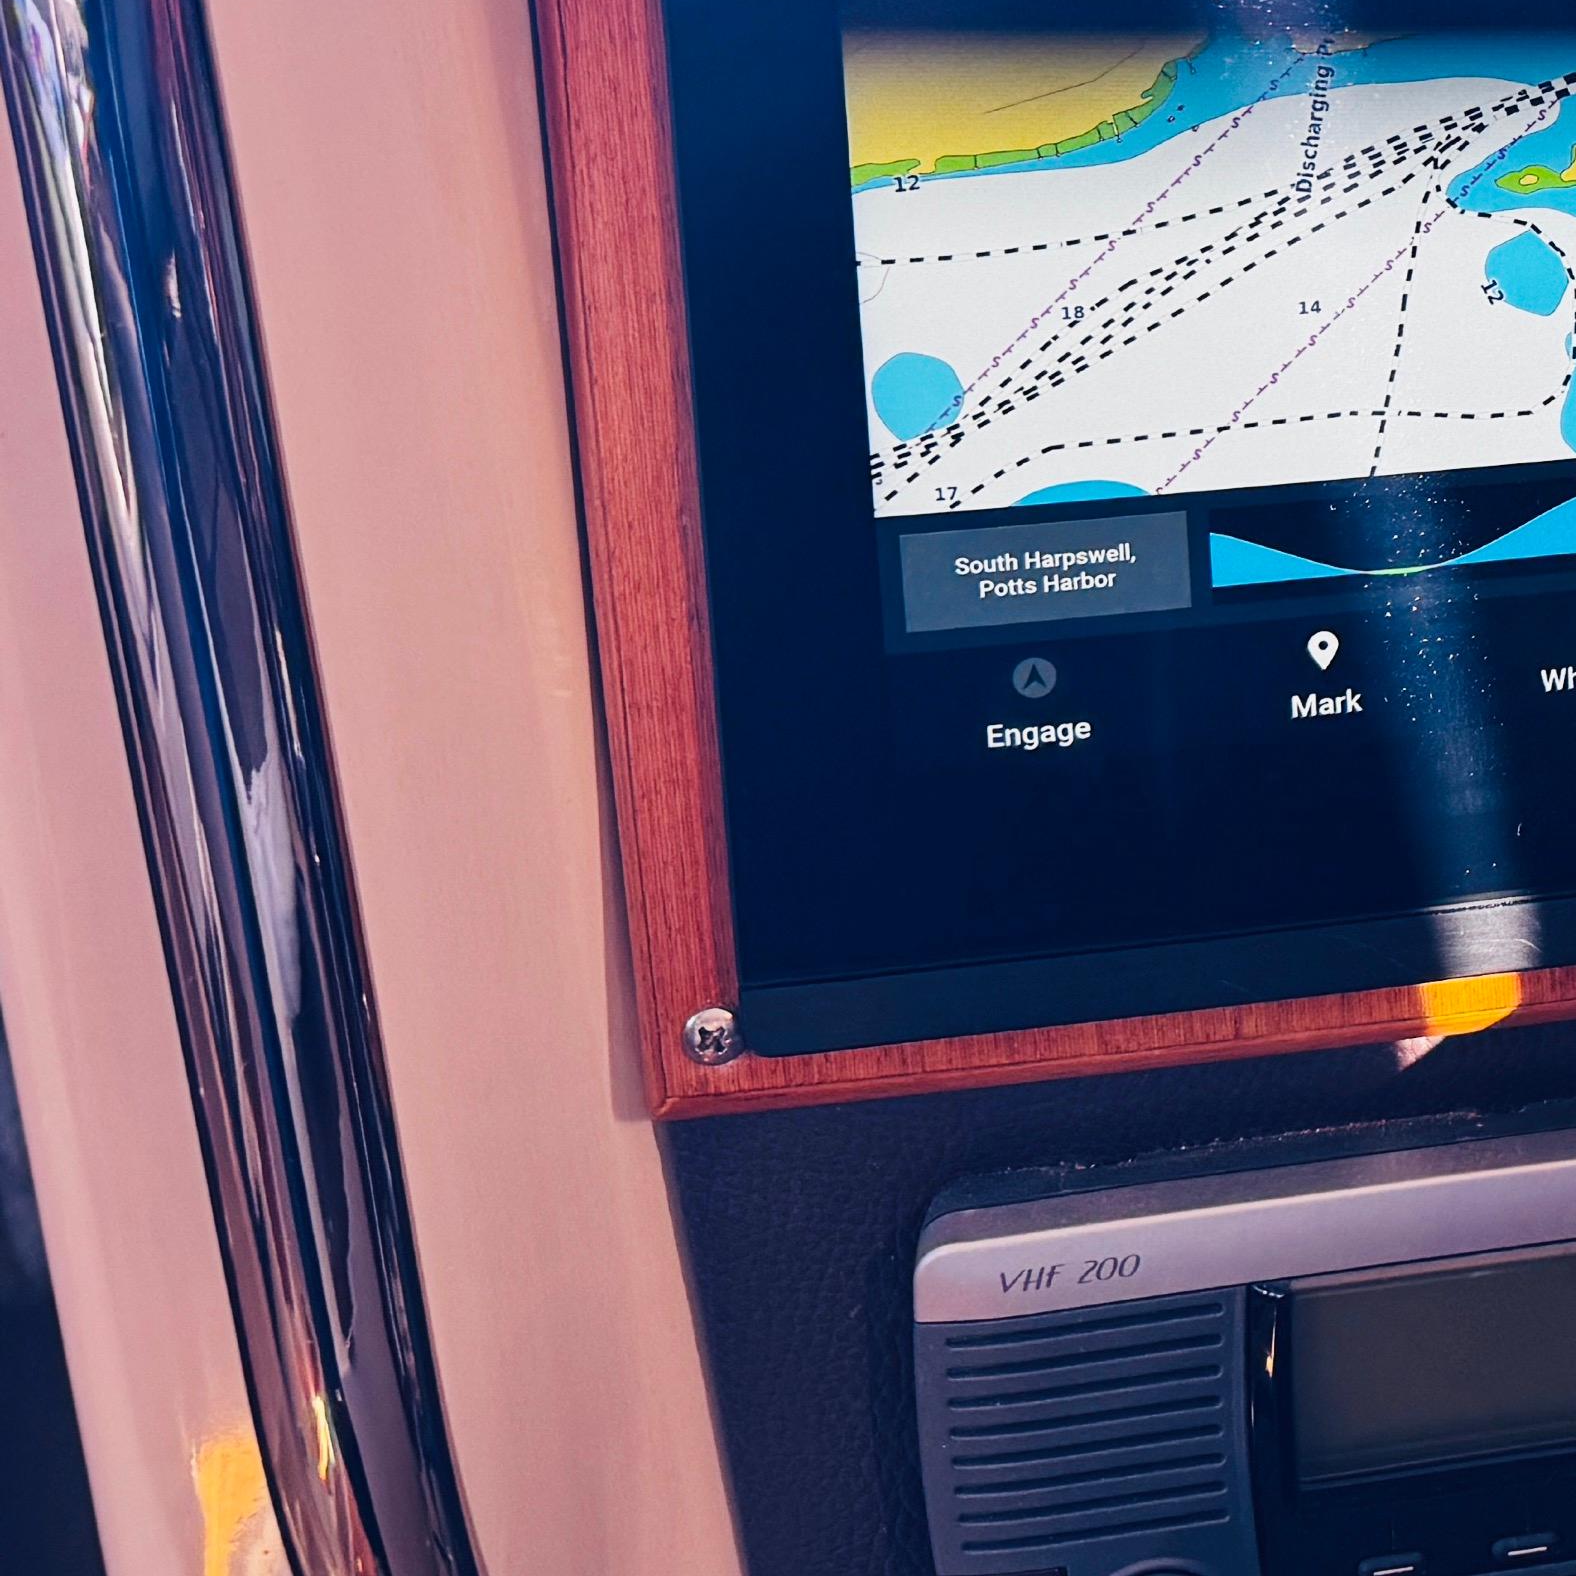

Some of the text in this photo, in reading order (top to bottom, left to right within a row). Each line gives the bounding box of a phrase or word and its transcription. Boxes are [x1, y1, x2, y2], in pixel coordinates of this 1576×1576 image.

[1295, 64, 1336, 194] Discharging
[894, 175, 921, 193] 12
[1480, 278, 1505, 305] 12
[1060, 305, 1086, 321] 18
[1299, 300, 1323, 316] 14
[934, 487, 959, 503] 17
[953, 543, 1137, 577] South Harpswell,
[979, 570, 1117, 599] Potts Harbor
[1290, 688, 1363, 719] Mark
[985, 718, 1092, 751] Engage
[1000, 1253, 1141, 1294] VHF 200
